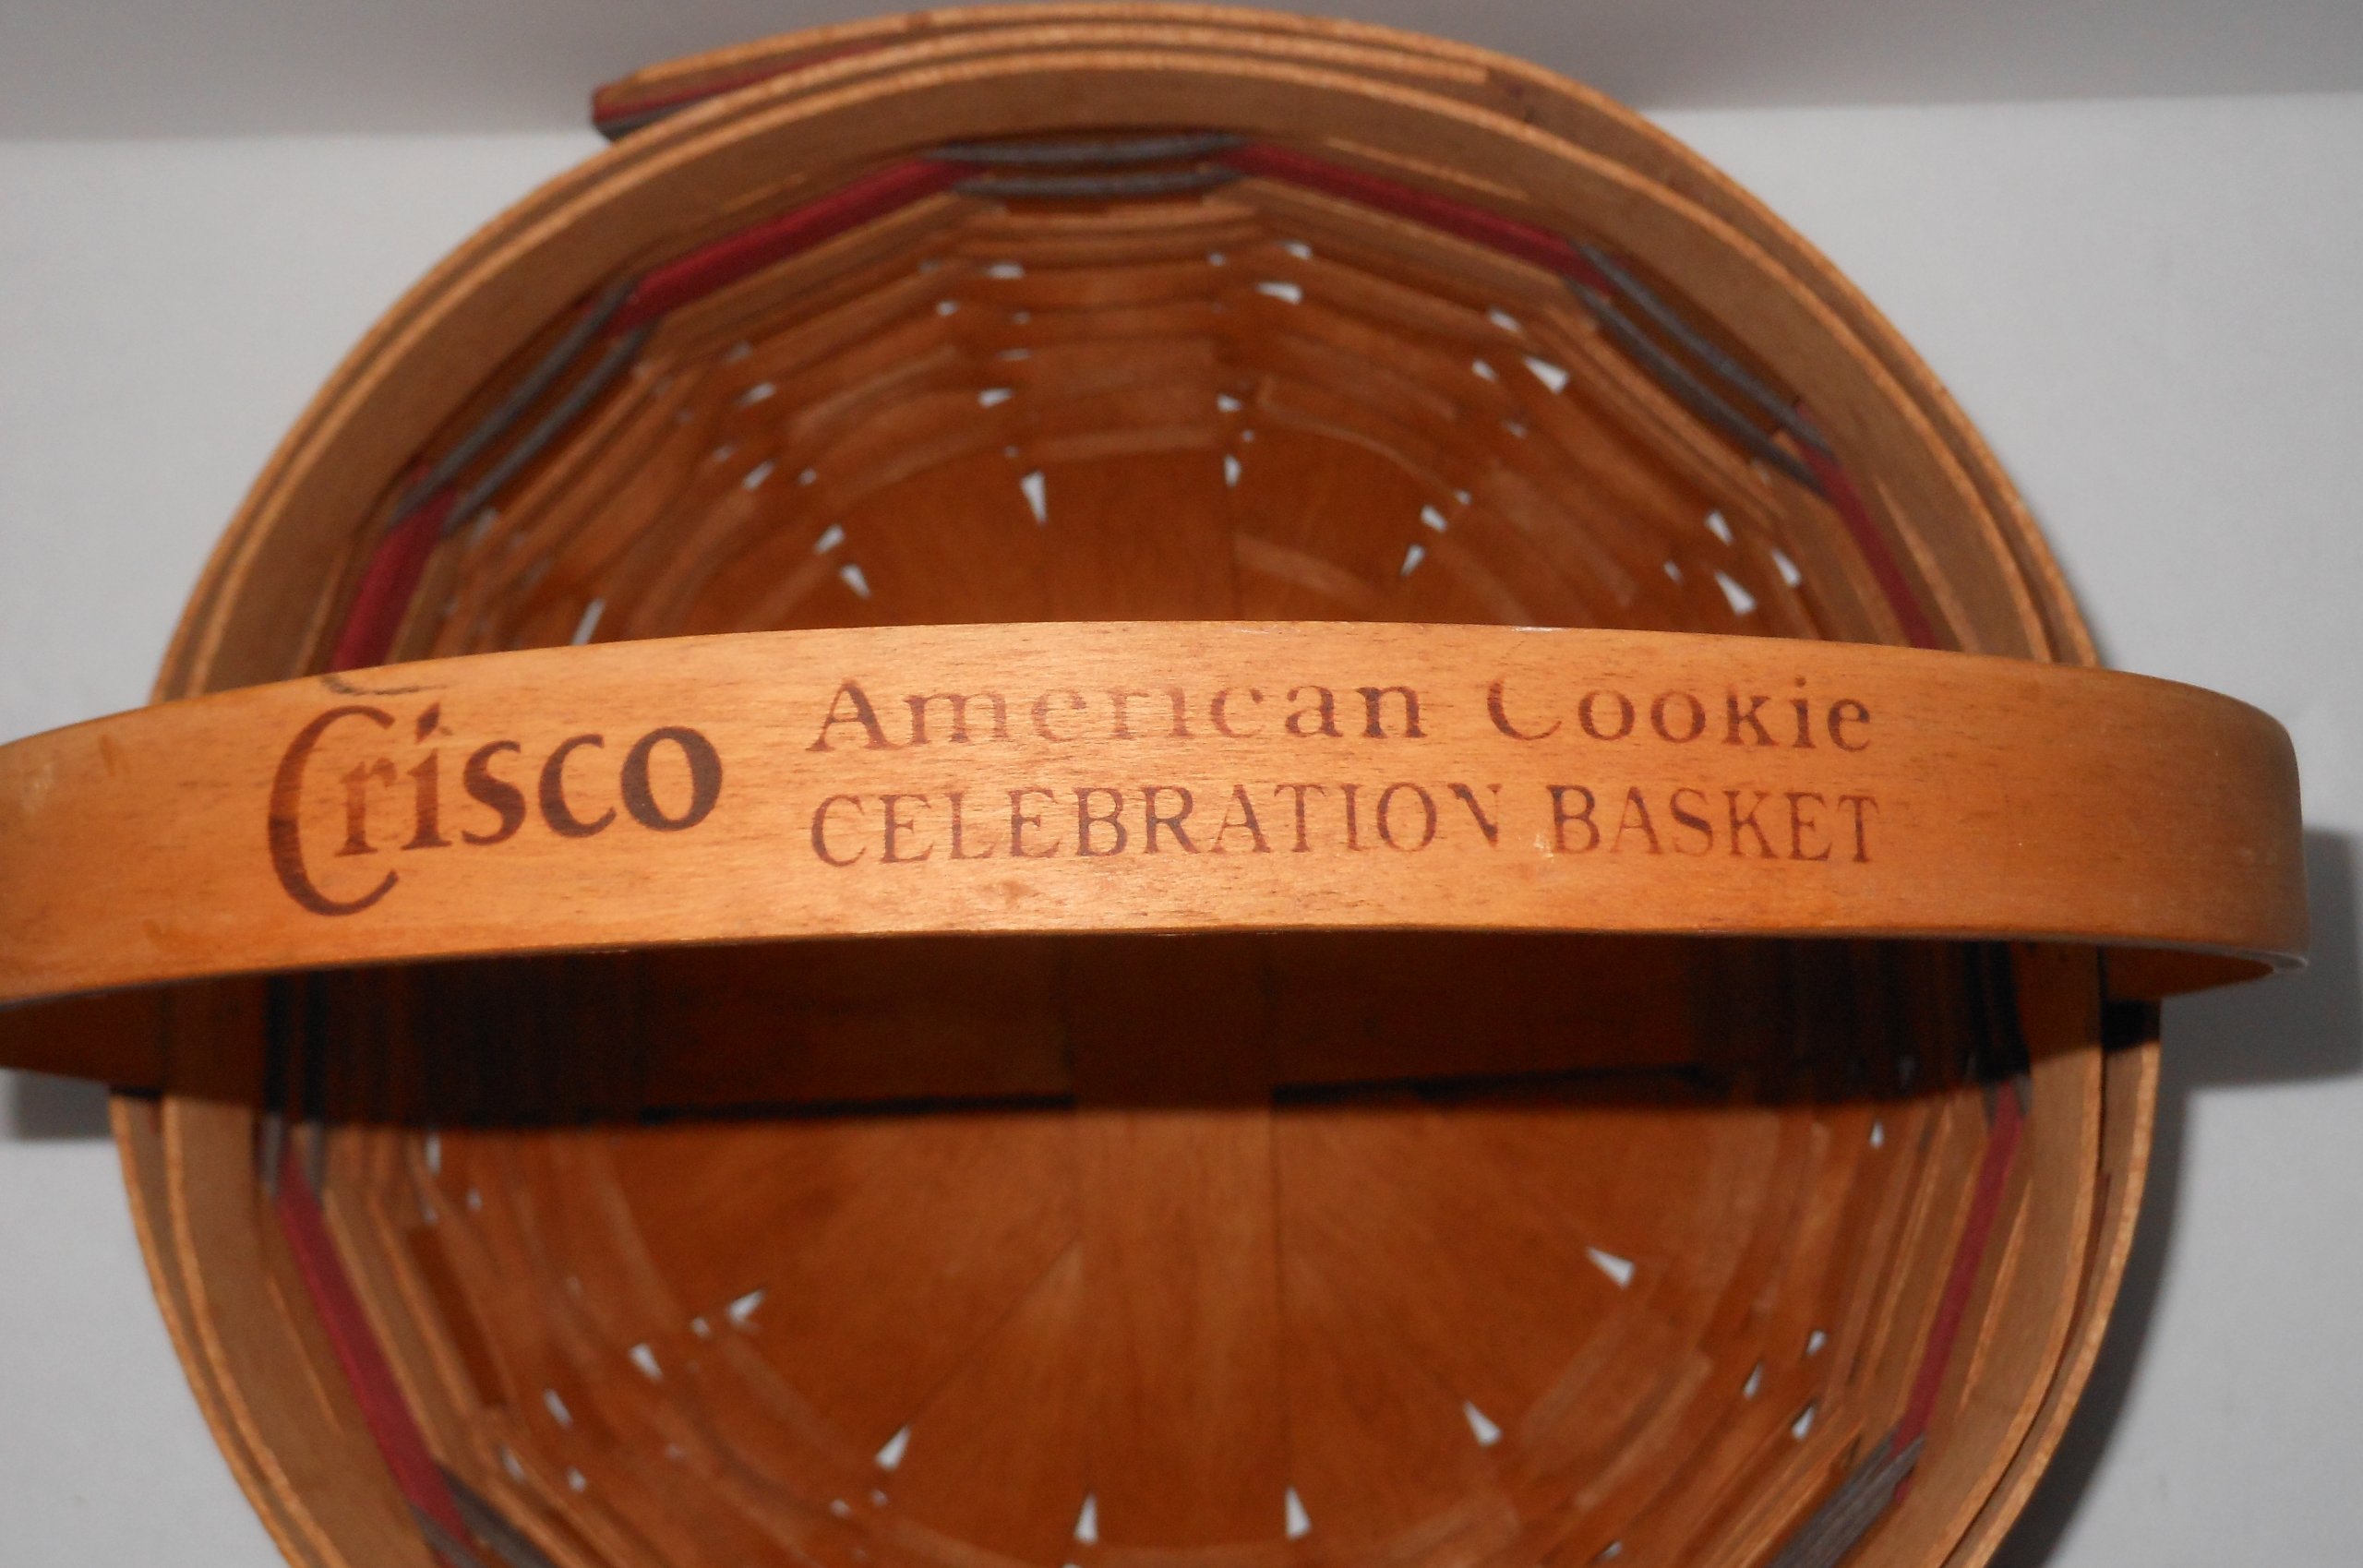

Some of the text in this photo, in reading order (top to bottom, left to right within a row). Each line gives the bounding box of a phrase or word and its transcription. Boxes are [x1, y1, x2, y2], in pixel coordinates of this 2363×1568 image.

[804, 676, 1872, 753] American Cookie
[267, 702, 724, 916] Crisco
[810, 782, 1880, 867] CELEBRATION BASKET
